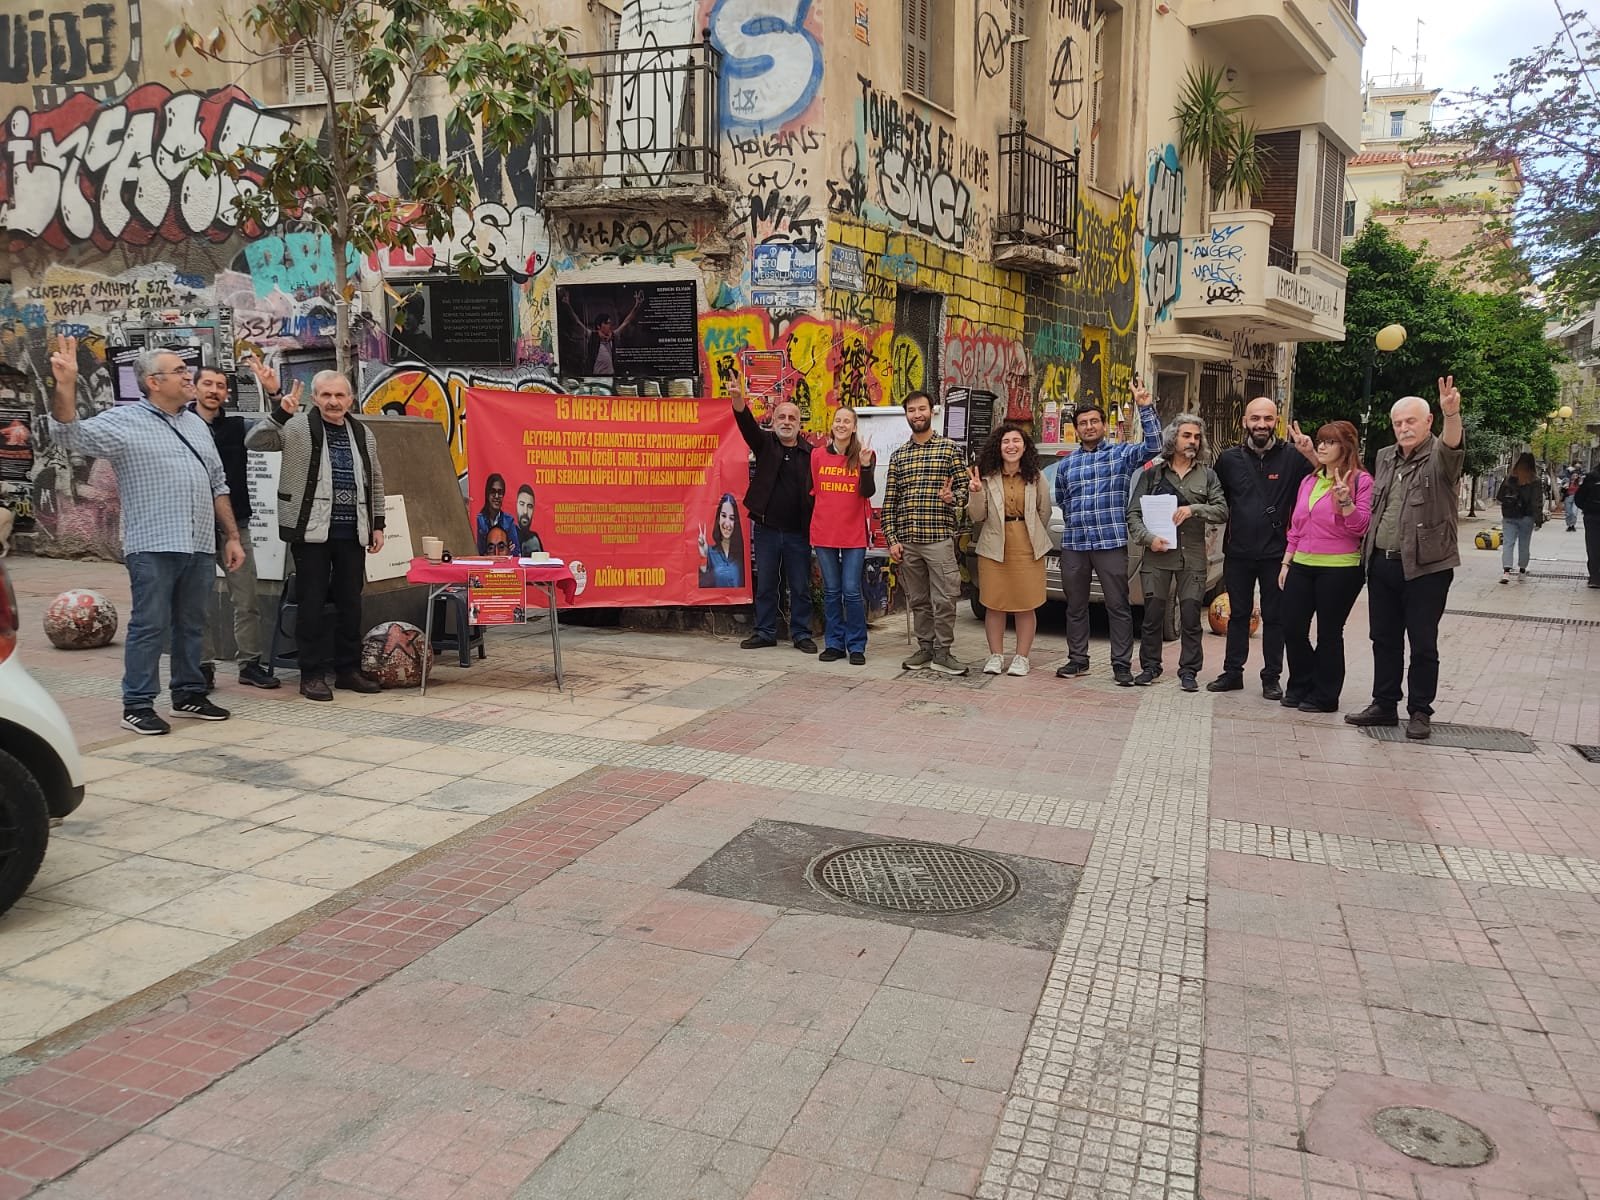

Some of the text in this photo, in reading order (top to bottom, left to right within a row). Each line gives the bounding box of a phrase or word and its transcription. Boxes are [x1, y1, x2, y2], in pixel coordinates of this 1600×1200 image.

[555, 398, 699, 424] 15 ΜΕΡΕΣ ΑΠΕΡΓΙΑ ΠΕΙΝΑΣ
[523, 430, 561, 446] ΛΕΥΤΕΡΙΑ
[562, 431, 586, 447] ΣΤΟΥΣ
[587, 432, 592, 447] 4
[820, 482, 856, 493] ΠΕΙΝΑΣ
